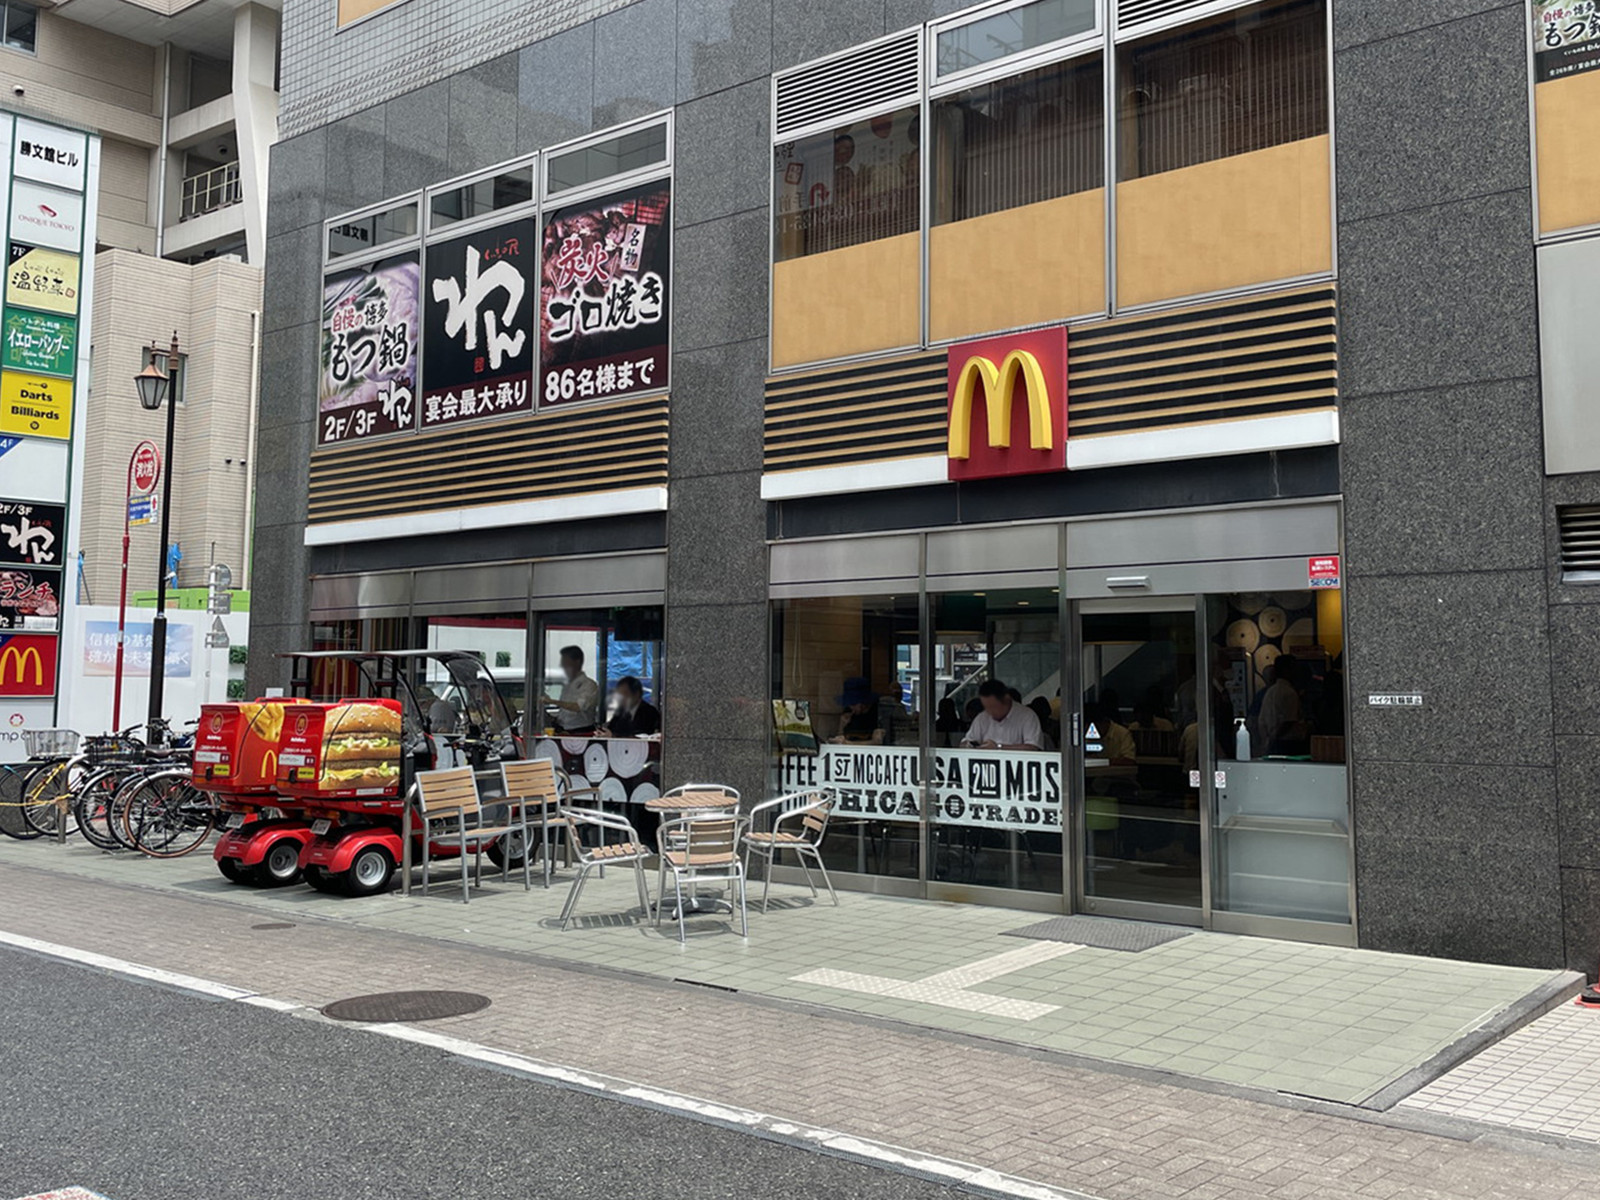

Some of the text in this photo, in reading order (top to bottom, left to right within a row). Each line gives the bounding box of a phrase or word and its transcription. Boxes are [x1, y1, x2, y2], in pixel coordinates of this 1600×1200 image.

[12, 246, 26, 257] 7F
[558, 239, 609, 287] 炭火
[623, 228, 641, 266] 名物
[333, 300, 388, 333] 自慢の博多
[432, 245, 526, 370] わん
[549, 276, 661, 339] ゴロ焼き
[332, 322, 408, 381] もつ鍋
[20, 389, 53, 402] Darts
[545, 357, 655, 402] 86名様まで
[11, 405, 60, 421] Billiards
[378, 378, 412, 429] わん
[425, 380, 527, 423] 宴会最大承り
[324, 408, 377, 442] 2F/3F
[1, 516, 55, 564] わん
[1, 581, 53, 599] ランチ
[779, 754, 817, 787] FEE
[853, 754, 908, 786] MCCAFE
[972, 763, 997, 795] 2ND
